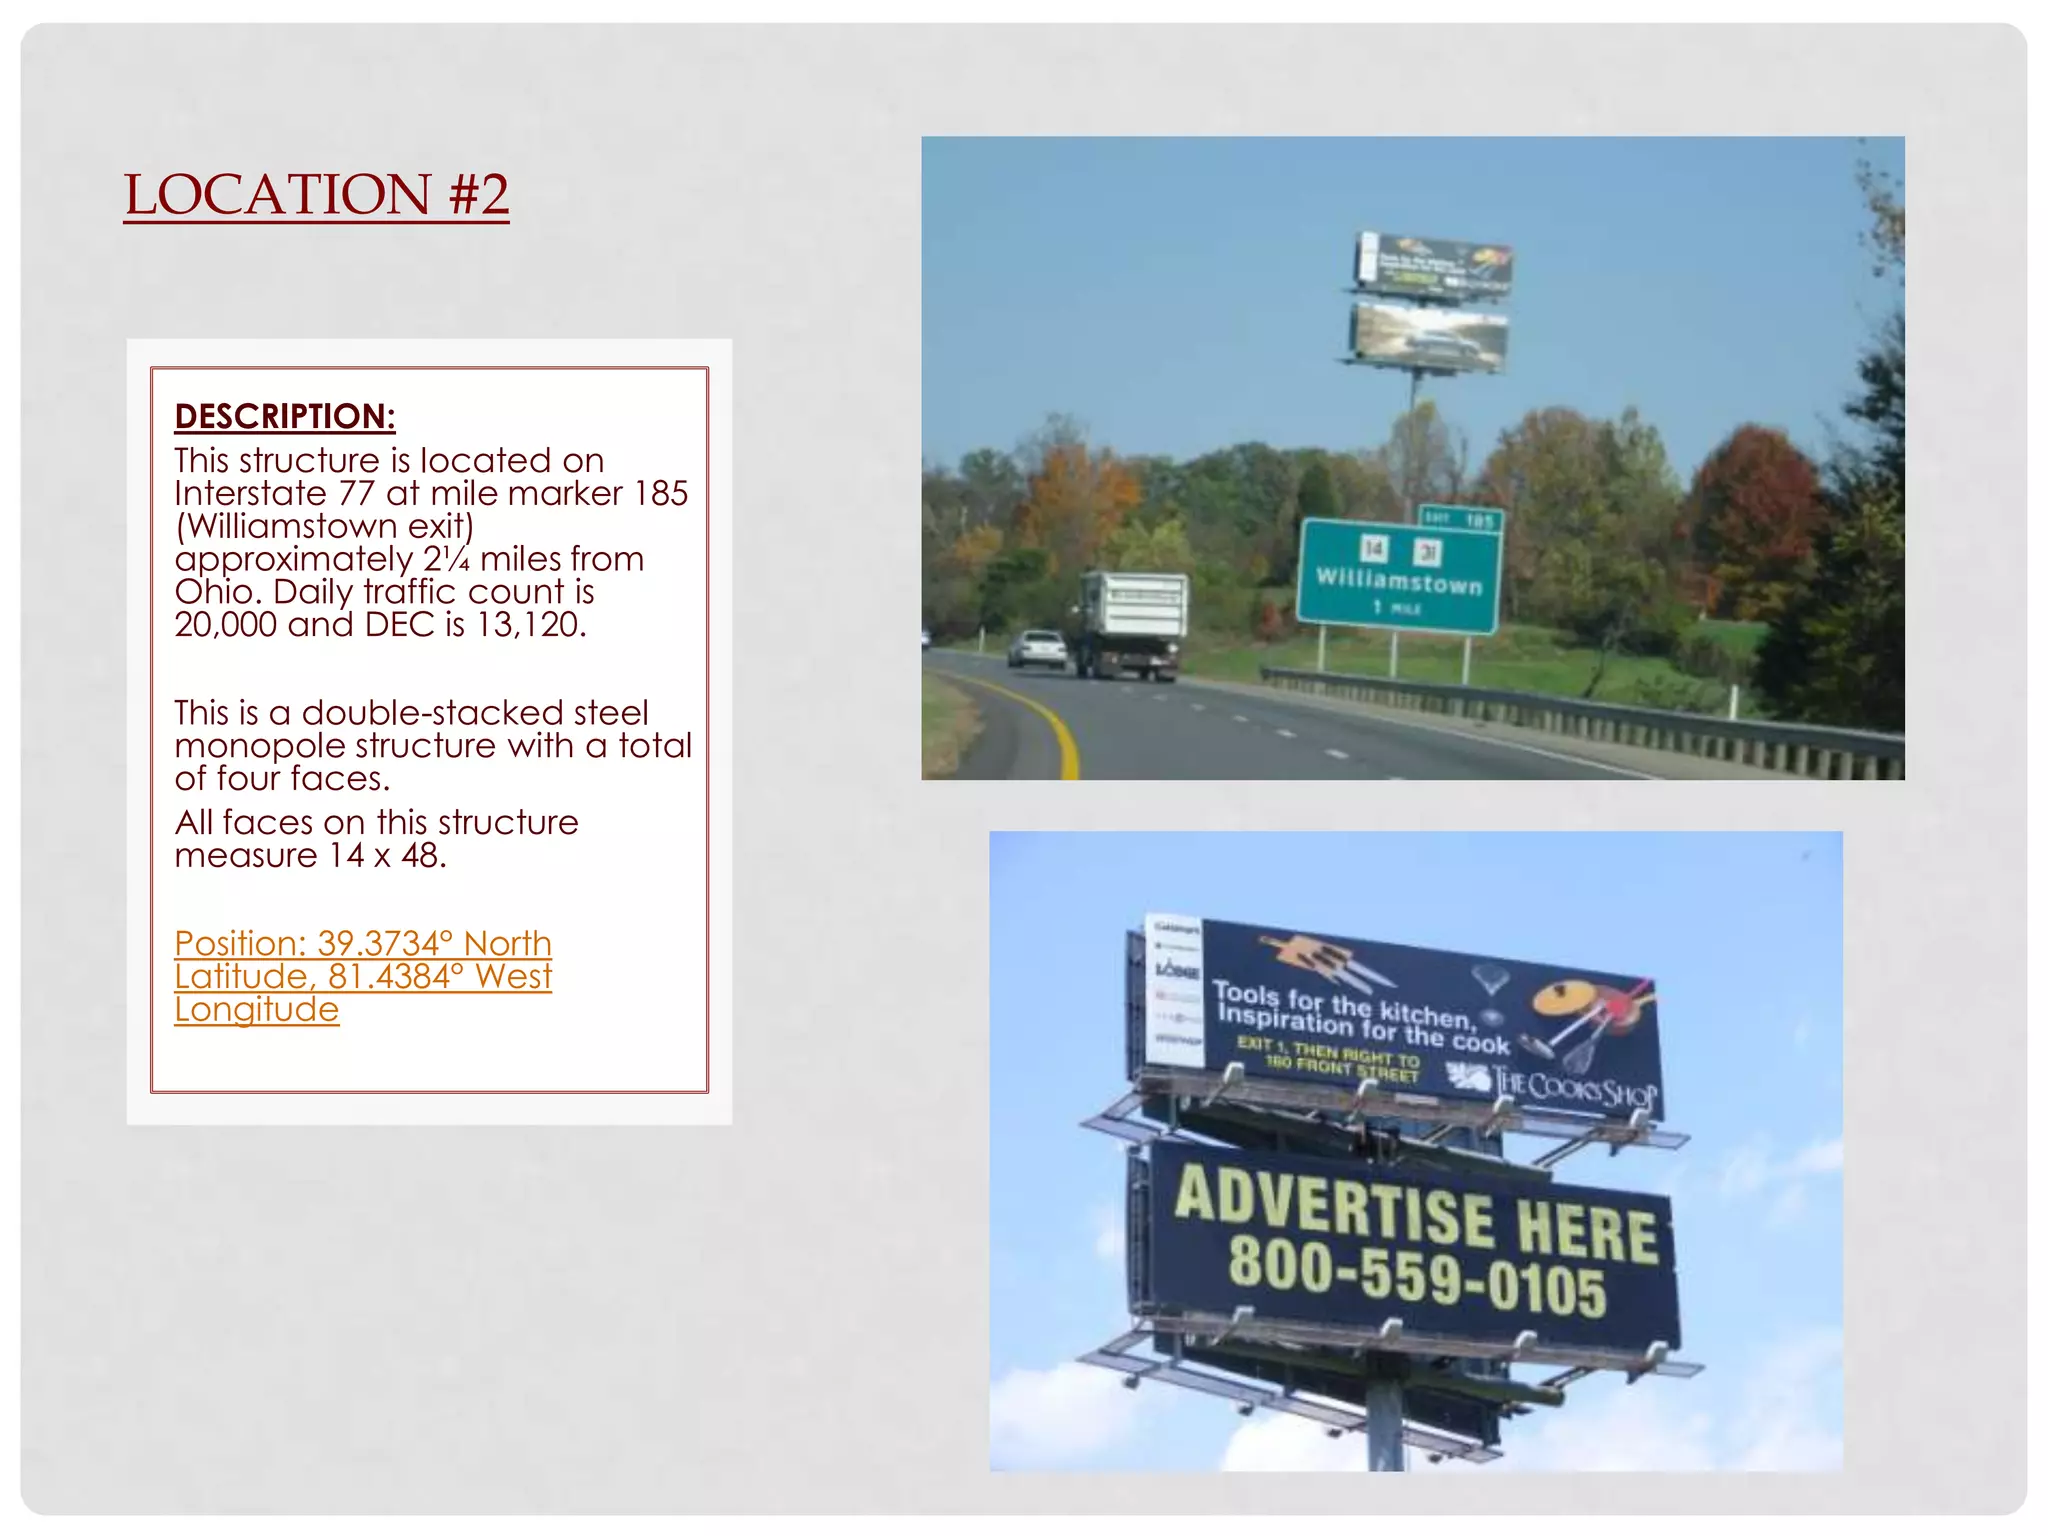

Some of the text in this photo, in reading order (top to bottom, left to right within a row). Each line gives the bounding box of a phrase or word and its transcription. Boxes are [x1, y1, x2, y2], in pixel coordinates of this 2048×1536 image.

[1465, 513, 1495, 530] 185
[1365, 539, 1437, 561] 14 31
[1316, 565, 1484, 597] Williamstown
[1373, 599, 1422, 616] 1 MILE
[1212, 979, 1280, 1008] Tools
[1288, 988, 1324, 1012] for
[1331, 995, 1372, 1019] the
[1380, 999, 1478, 1035] kitchen,
[1218, 1002, 1352, 1037] Inspiration
[1362, 1023, 1398, 1045] for
[1404, 1026, 1445, 1048] the
[1452, 1033, 1512, 1056] cook
[1236, 1035, 1273, 1051] EXIT
[1293, 1041, 1339, 1060] THEN
[1343, 1046, 1394, 1066] RIGHT
[1398, 1053, 1421, 1069] TO
[1296, 1057, 1355, 1077] FRONT
[1356, 1065, 1420, 1084] STREET
[1174, 1162, 1660, 1266] ADVERTISE HERE
[1228, 1234, 1608, 1320] 800-559-0105
